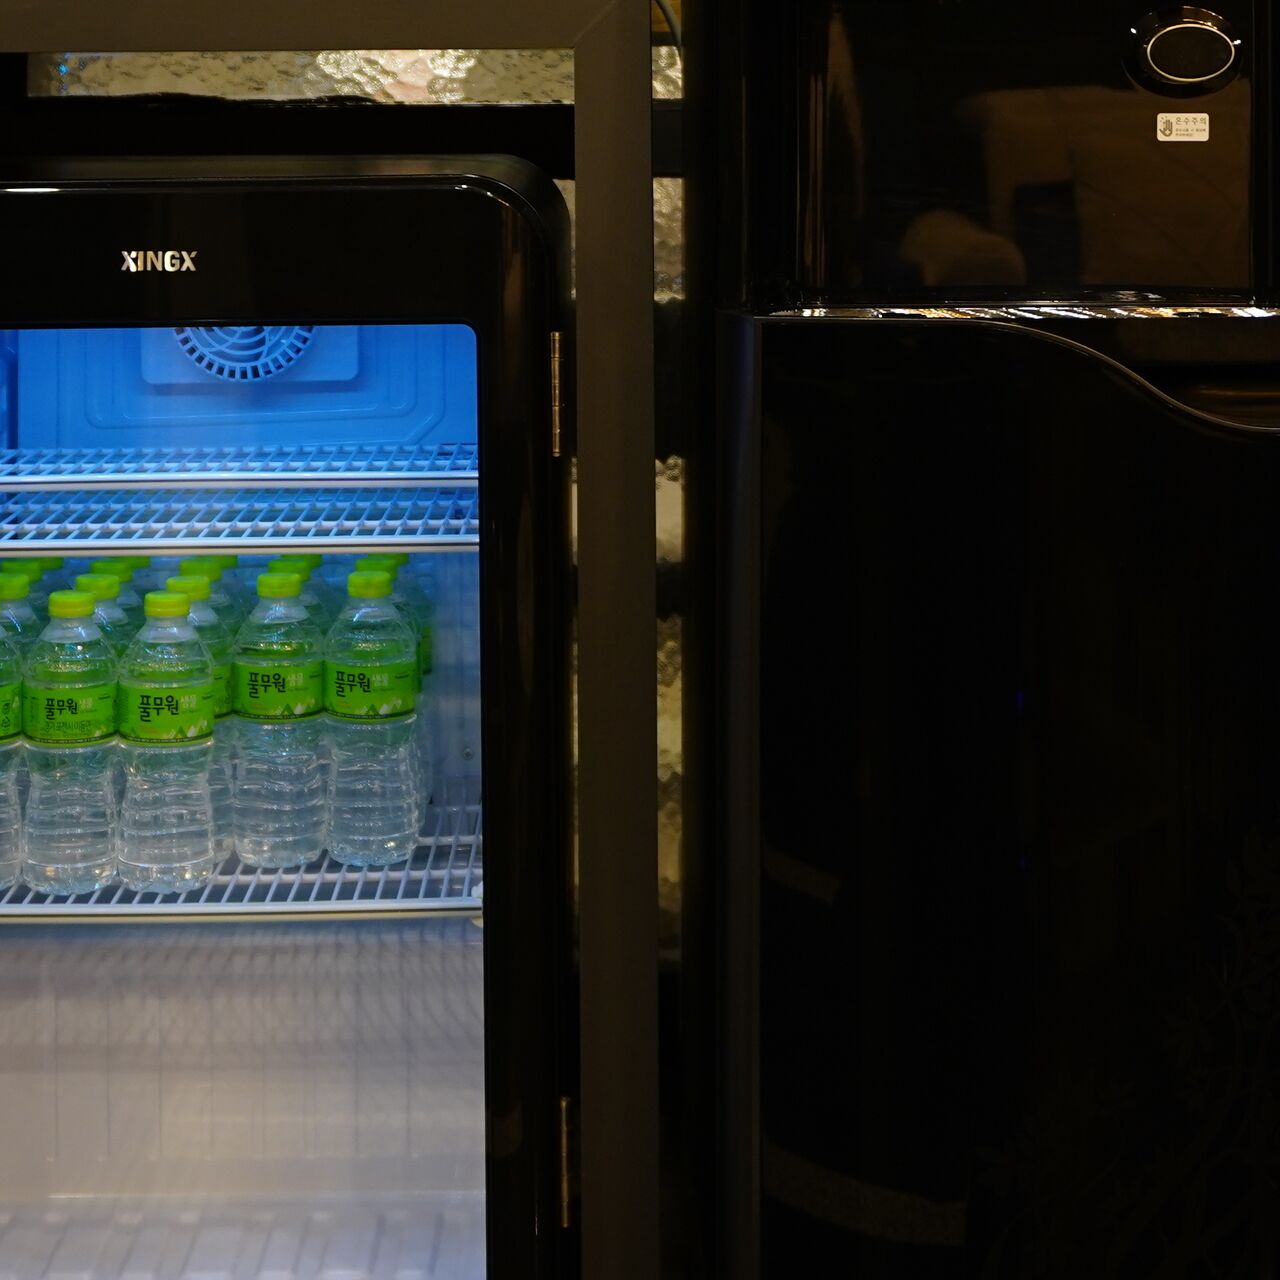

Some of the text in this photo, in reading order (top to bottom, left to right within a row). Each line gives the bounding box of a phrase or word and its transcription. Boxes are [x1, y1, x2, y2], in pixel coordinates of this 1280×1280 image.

[121, 251, 198, 272] XINGX
[248, 672, 286, 699] 풀무원
[334, 671, 371, 697] 풀무원
[44, 698, 78, 720] 풀무원
[138, 695, 179, 722] 풀무원
